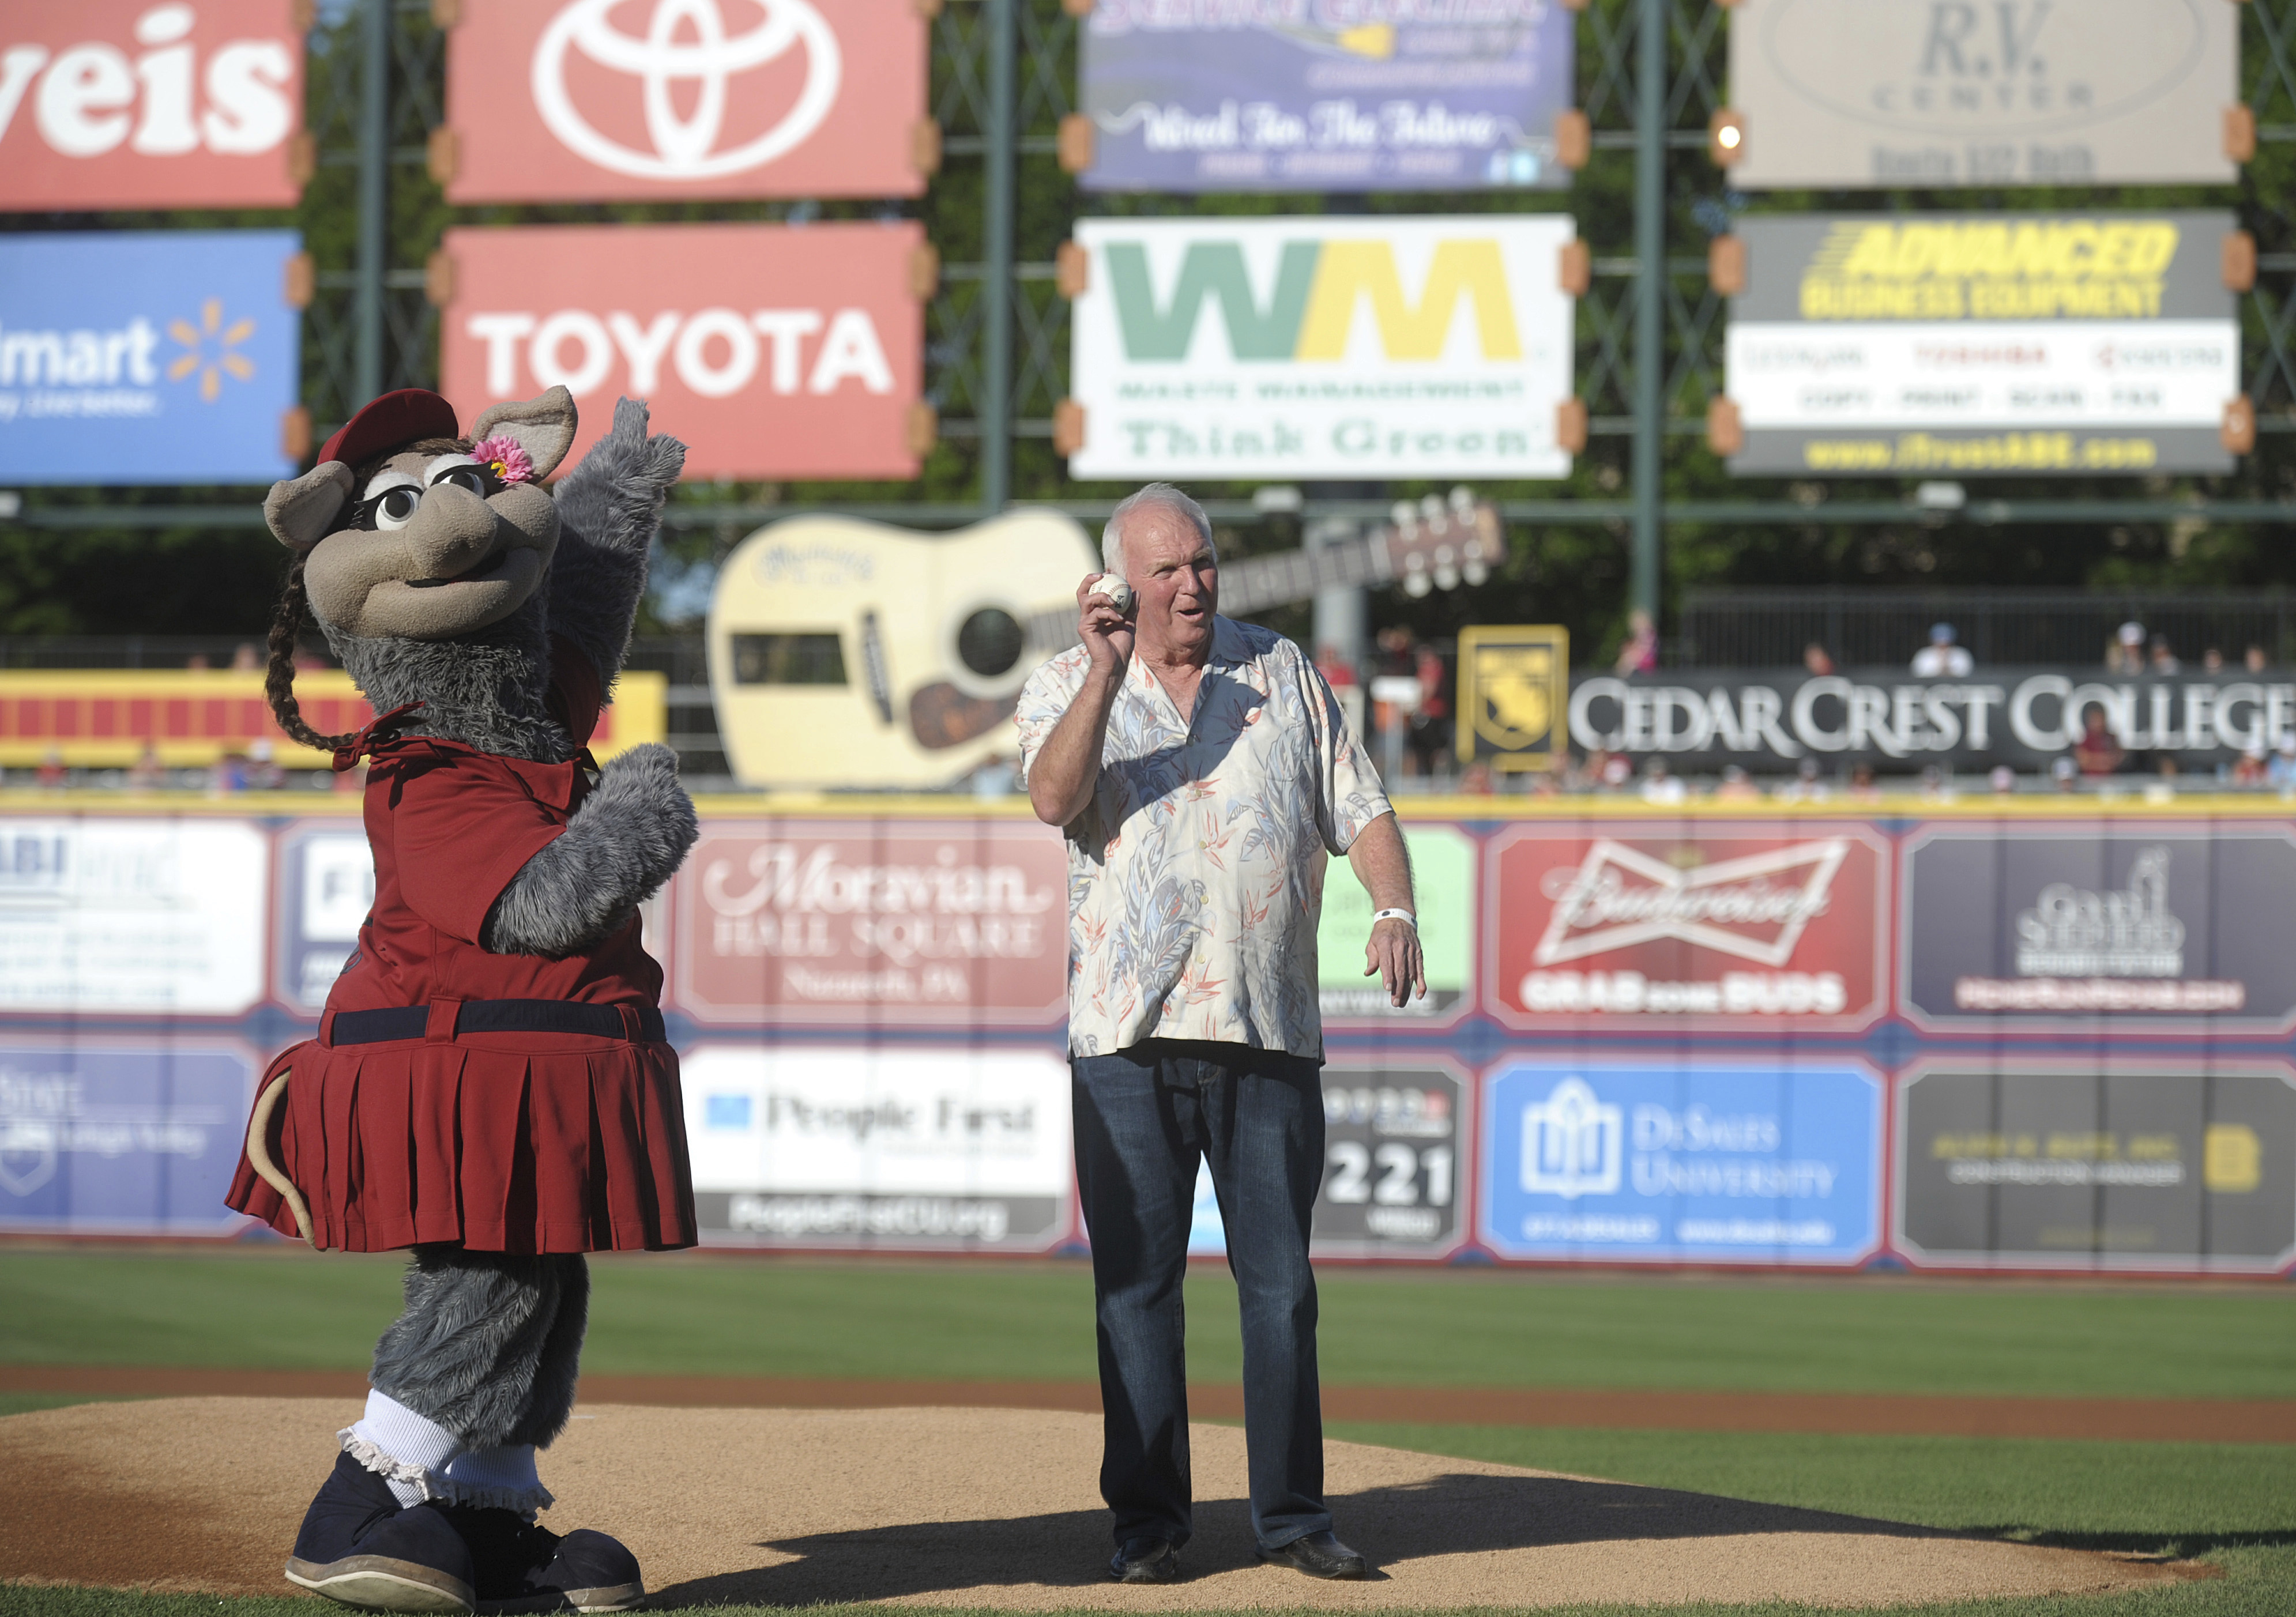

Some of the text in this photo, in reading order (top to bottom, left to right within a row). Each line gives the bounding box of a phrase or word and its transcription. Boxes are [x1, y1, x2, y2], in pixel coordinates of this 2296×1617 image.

[1873, 84, 2094, 111] CENTER
[1839, 220, 2180, 276] ADVANCED
[1105, 240, 1525, 361] WM
[1801, 279, 2166, 319] BUSINESS EQUIPMENT
[0, 317, 159, 387] mart
[469, 309, 895, 398] TOYOTA
[1257, 379, 1525, 399] MANAGEMENT
[1121, 418, 1304, 459] Think
[1568, 675, 2296, 756] CEDAR CREST COLLEGE
[703, 843, 1055, 914] Moravian
[1542, 866, 1830, 927] Budweiser
[713, 914, 1047, 966] HALL SQUARE
[1520, 971, 1646, 1012] GRAB
[1722, 973, 1847, 1013] BUDS
[768, 1095, 1036, 1143] People First
[1325, 1142, 1451, 1206] 221
